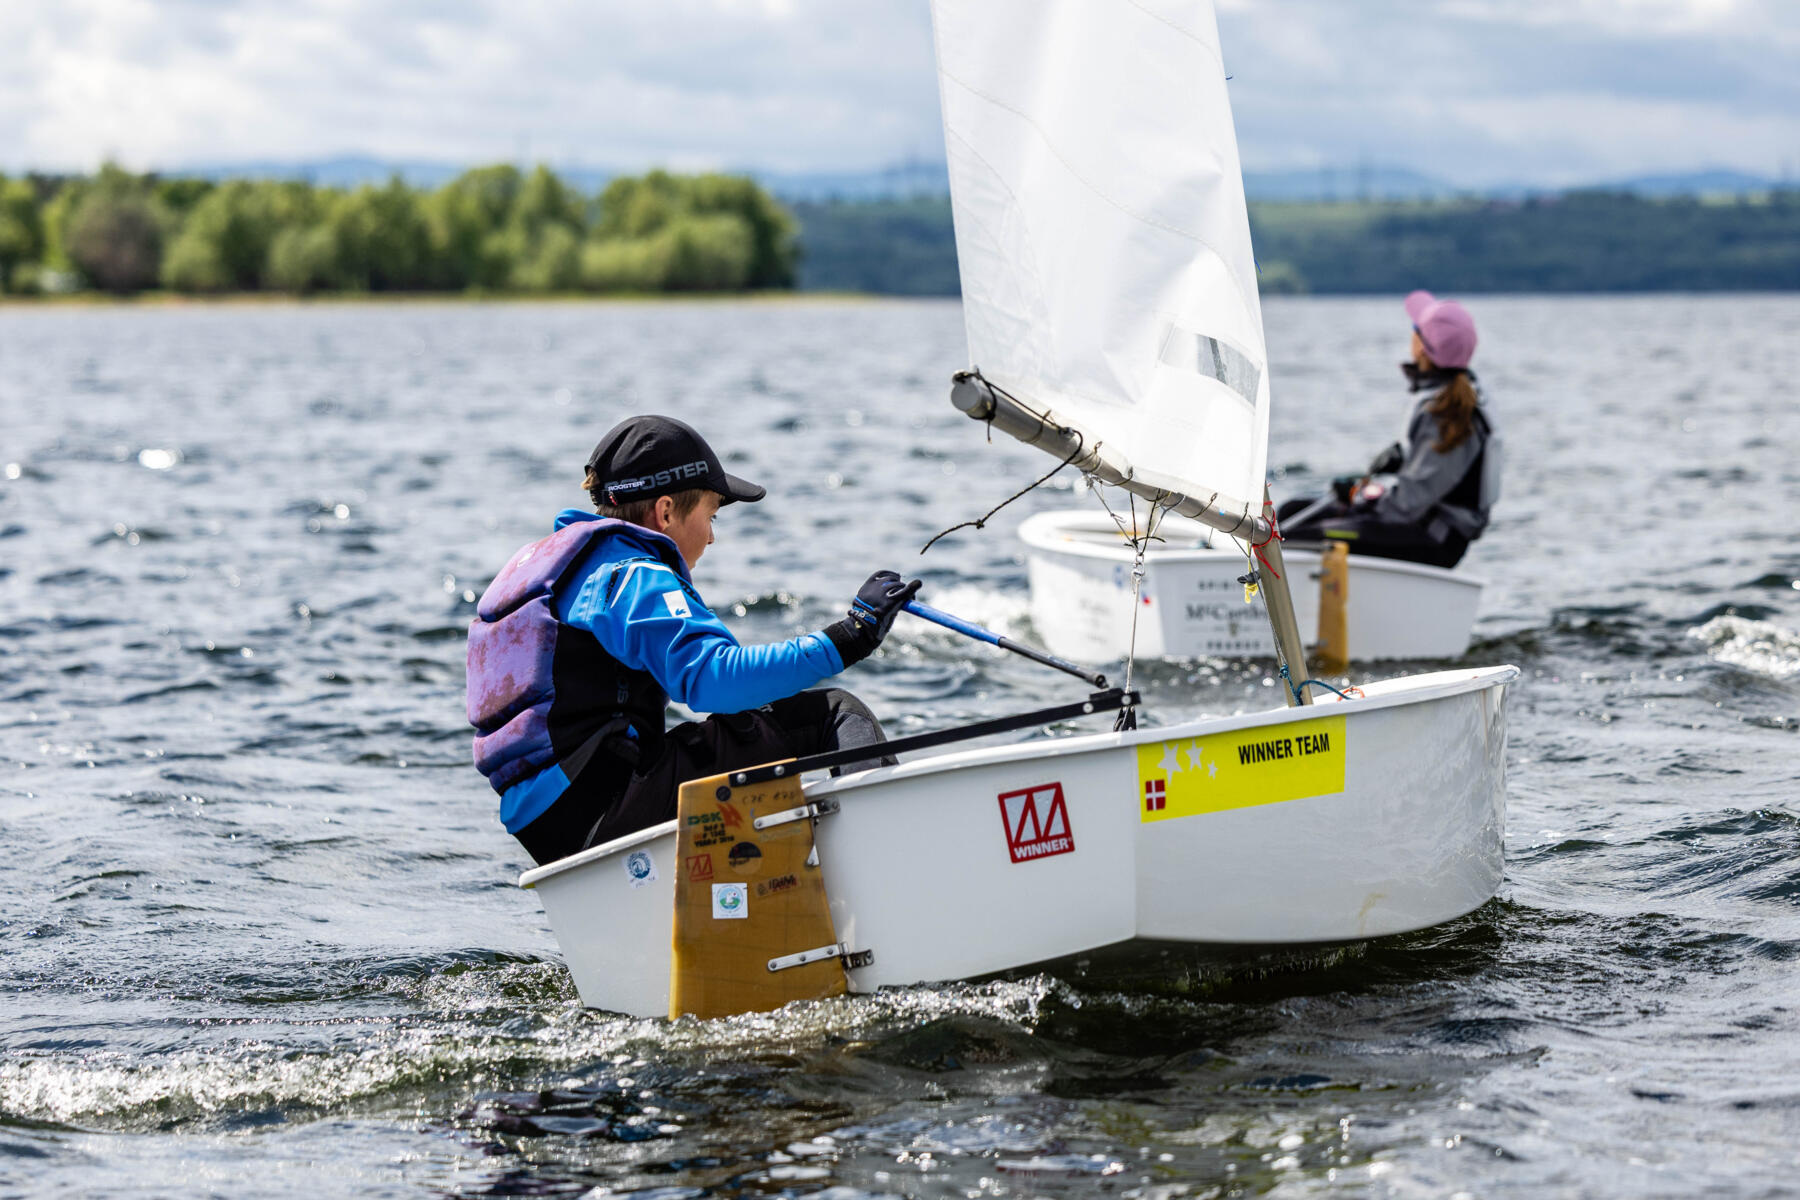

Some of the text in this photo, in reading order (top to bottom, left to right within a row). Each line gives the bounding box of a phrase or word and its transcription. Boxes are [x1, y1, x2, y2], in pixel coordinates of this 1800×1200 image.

[1238, 732, 1331, 765] WINNER TEAM
[687, 811, 723, 826] DSK
[1013, 838, 1070, 859] WINNER
